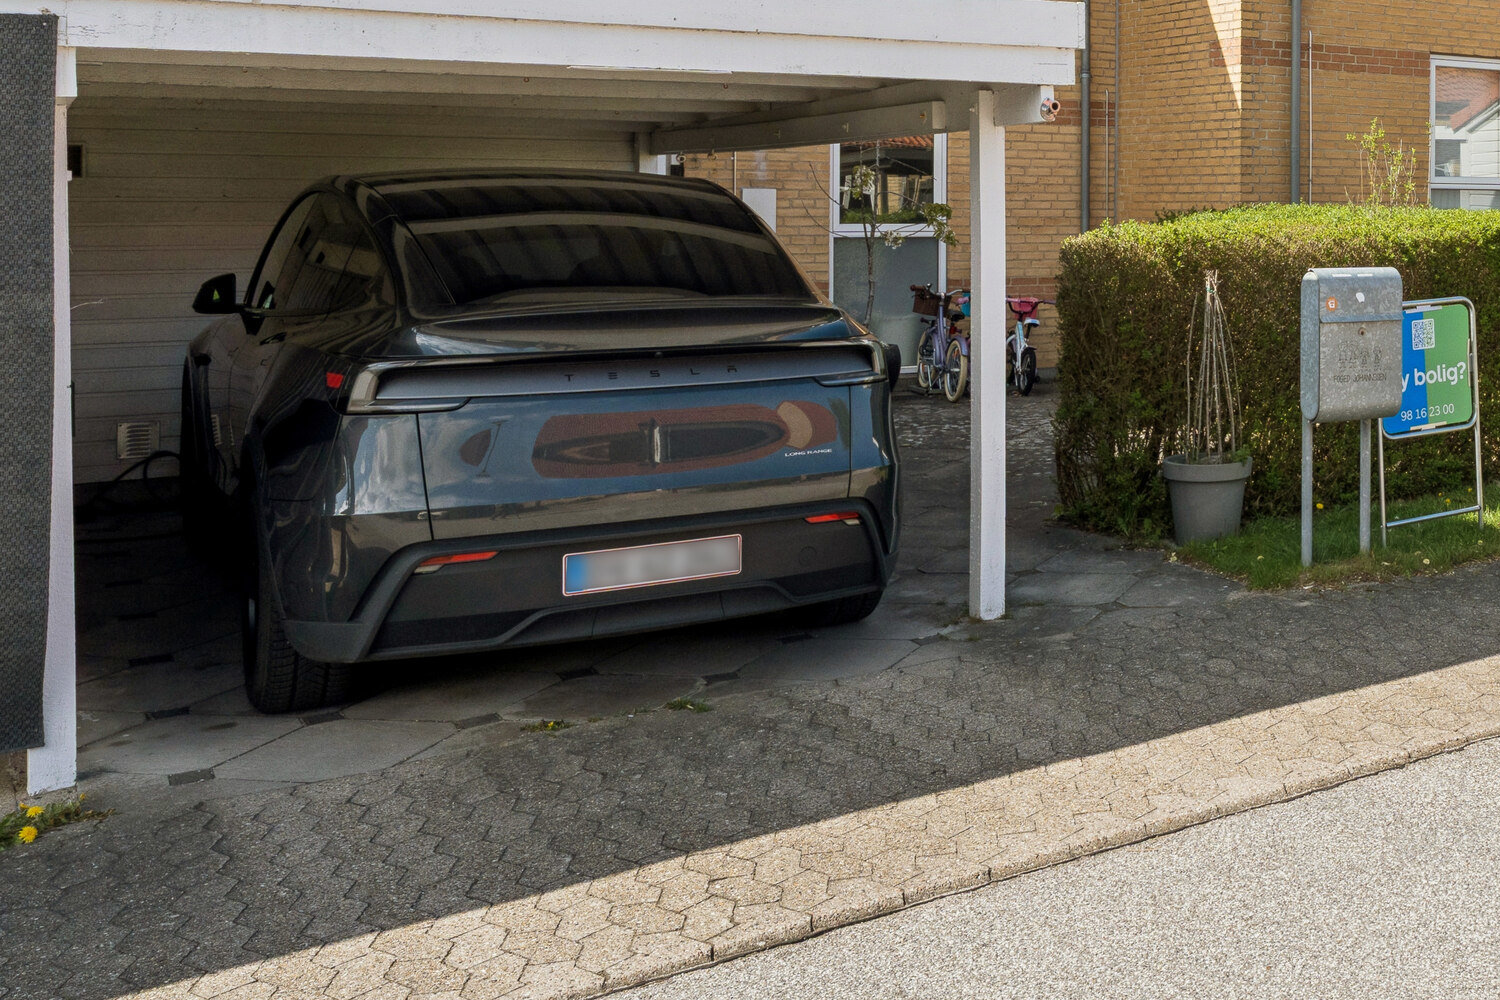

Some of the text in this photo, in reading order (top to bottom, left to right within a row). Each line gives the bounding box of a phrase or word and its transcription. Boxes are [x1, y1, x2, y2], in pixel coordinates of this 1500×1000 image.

[564, 365, 738, 382] TESLA
[1413, 361, 1467, 386] bolig?
[1400, 403, 1455, 421] 98 16 23 00
